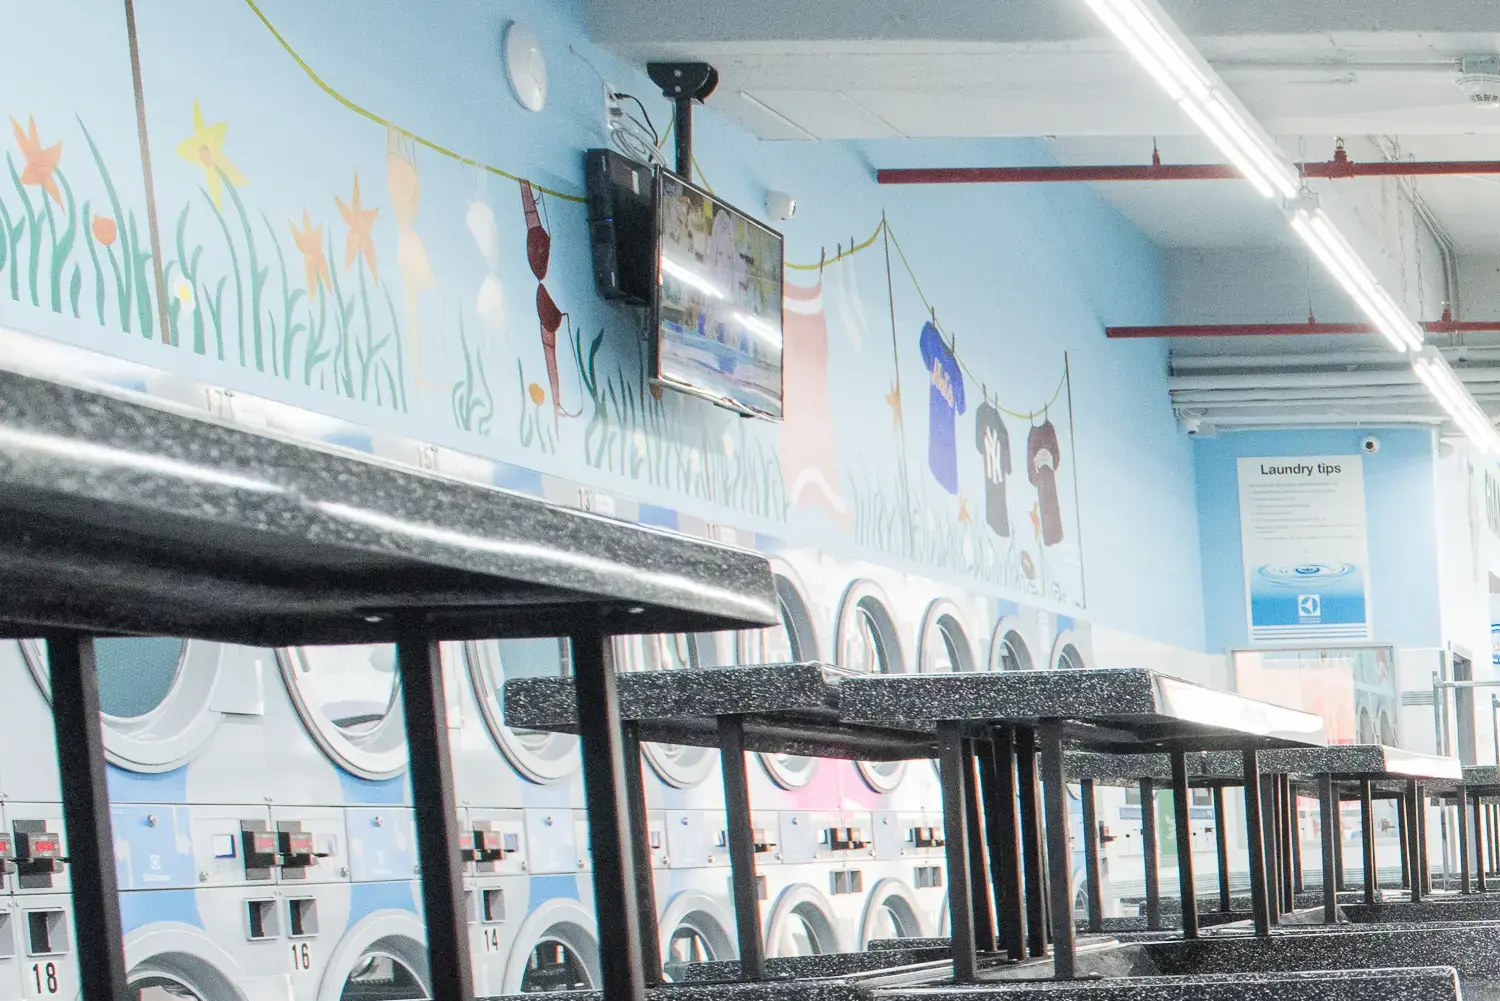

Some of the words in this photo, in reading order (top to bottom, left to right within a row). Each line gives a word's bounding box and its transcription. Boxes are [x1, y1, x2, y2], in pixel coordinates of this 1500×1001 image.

[1260, 463, 1313, 477] Laundry
[1317, 462, 1342, 476] tips
[484, 928, 499, 952] 14
[292, 943, 310, 970] 16
[33, 962, 57, 994] 18
